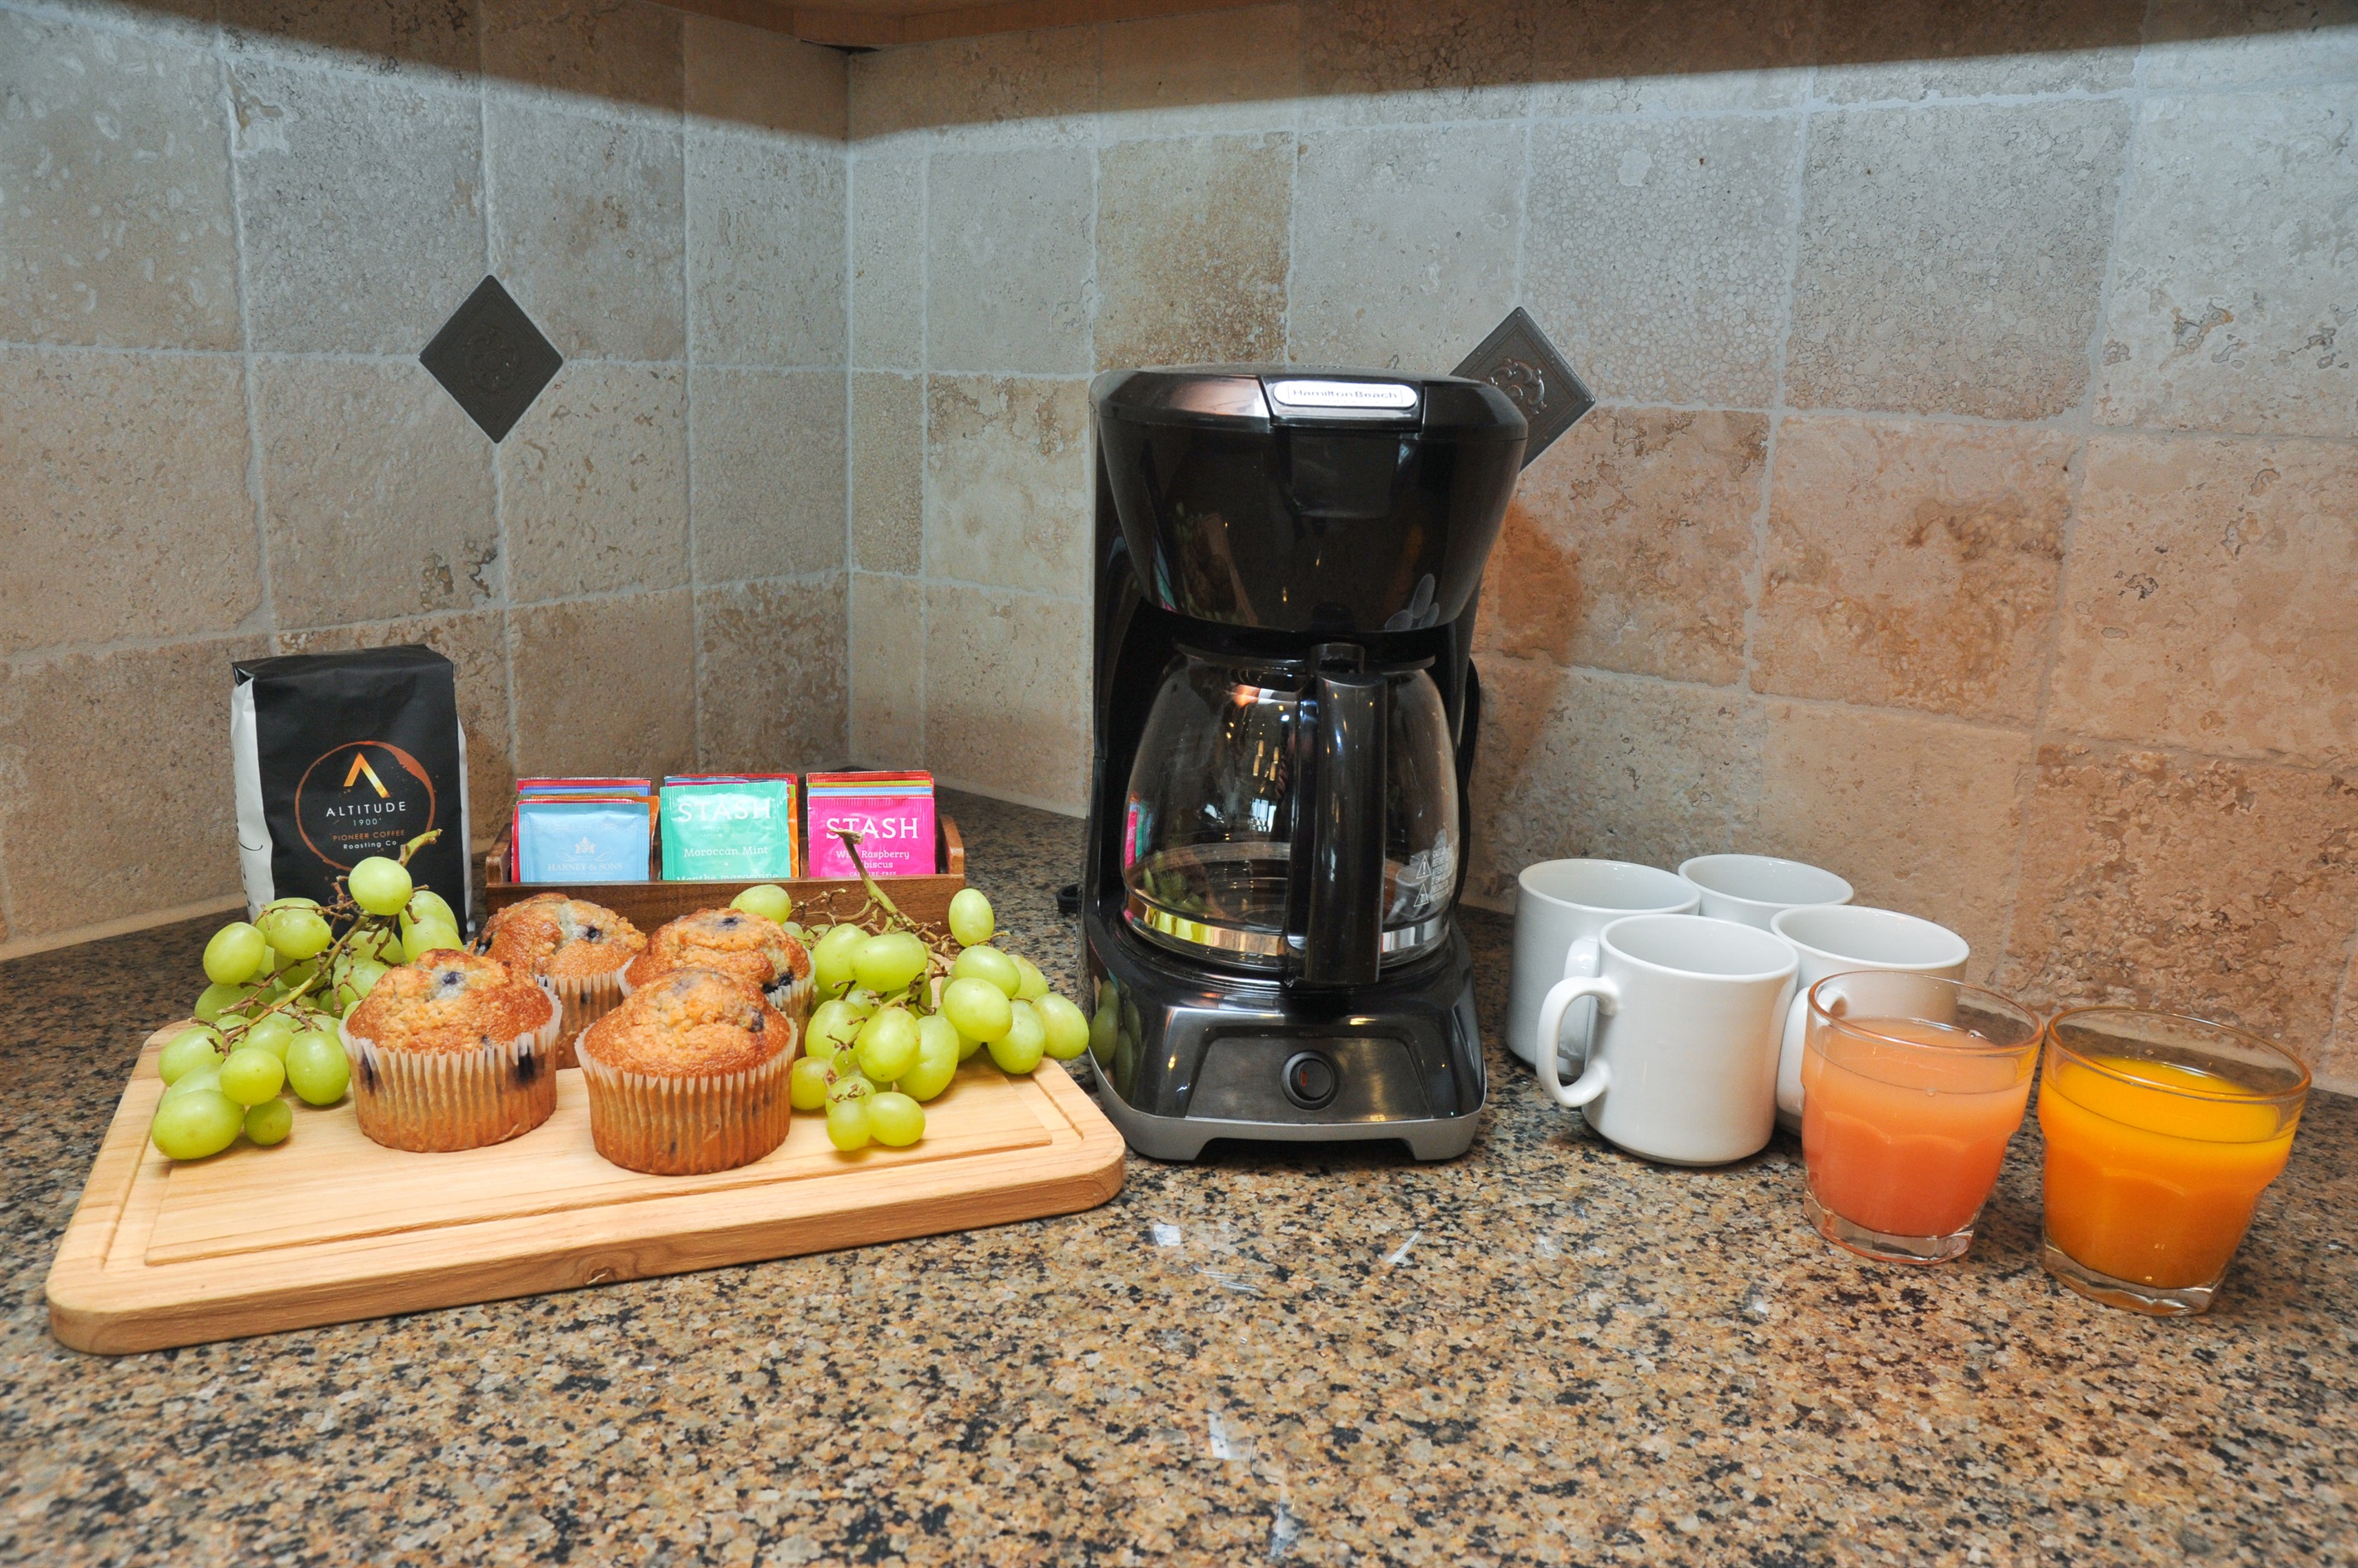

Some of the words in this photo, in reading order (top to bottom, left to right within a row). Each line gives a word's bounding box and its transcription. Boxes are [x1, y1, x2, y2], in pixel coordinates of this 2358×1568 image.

[325, 801, 406, 817] ALTITUDE
[678, 797, 771, 823] STASH
[826, 818, 918, 839] STASH
[333, 833, 369, 842] PIONEER
[373, 829, 405, 838] COFFEE
[343, 842, 381, 850] Roasting
[684, 848, 738, 857] Moroccan
[742, 846, 769, 856] Mint
[861, 850, 910, 860] Raspberry
[599, 862, 623, 871] SONS
[853, 861, 893, 869] biscus
